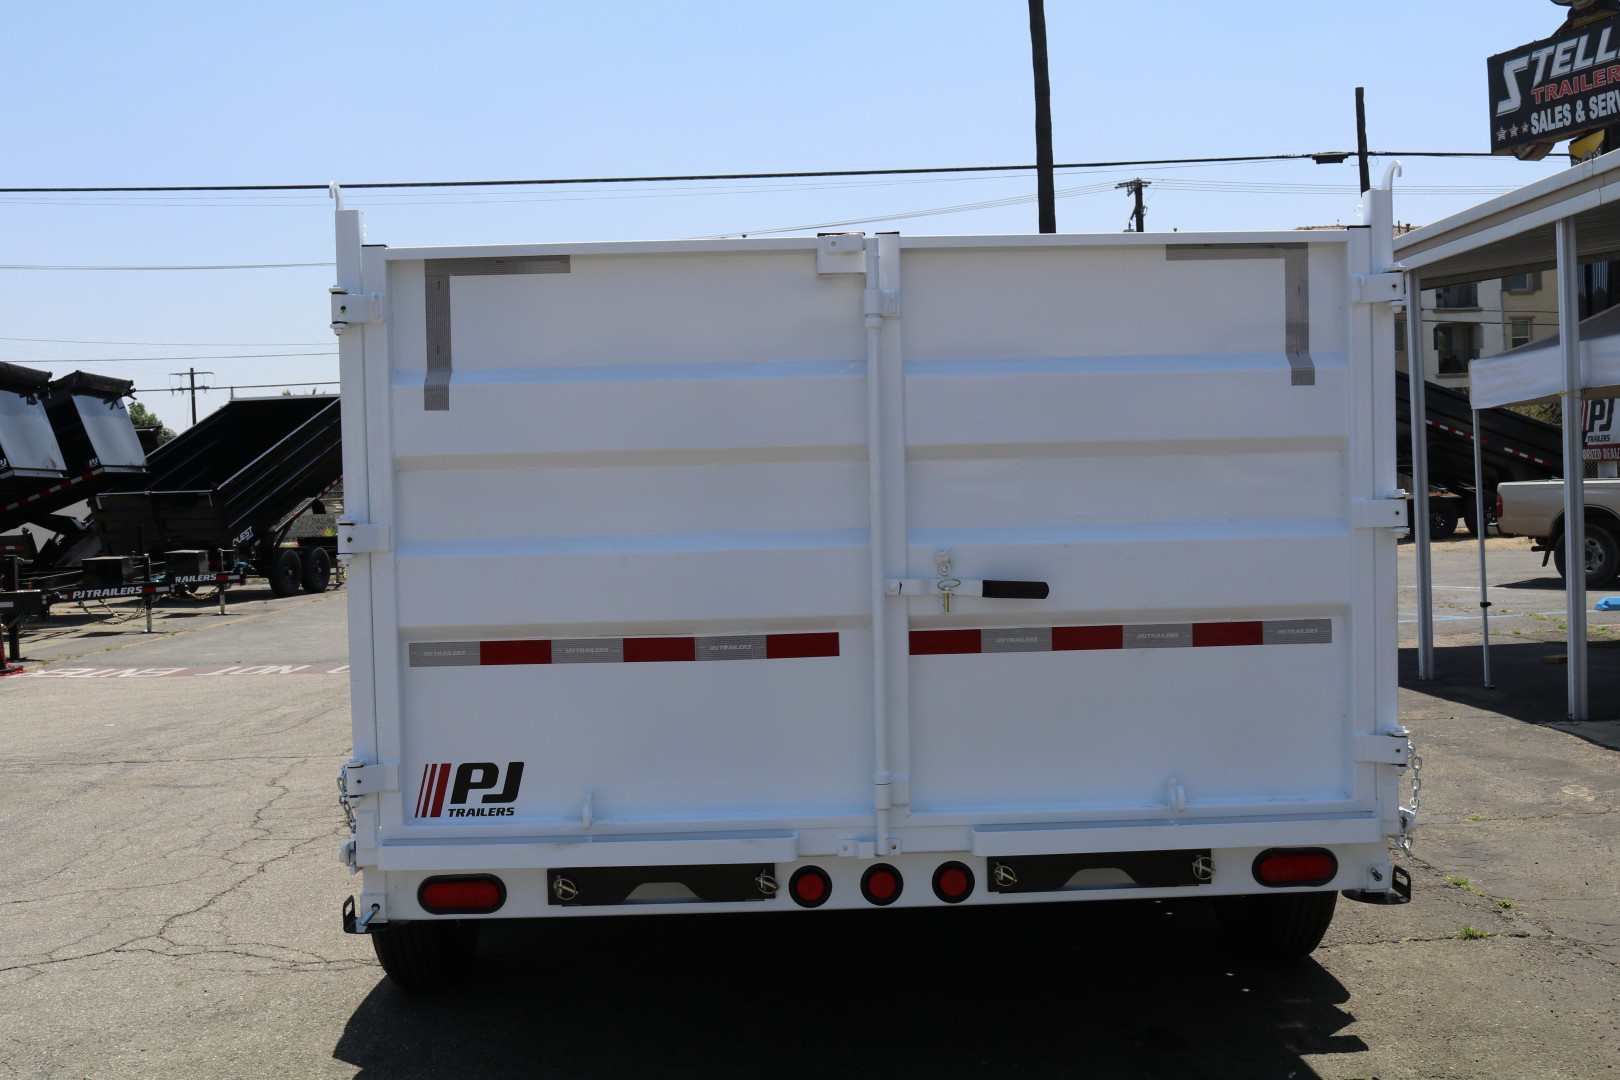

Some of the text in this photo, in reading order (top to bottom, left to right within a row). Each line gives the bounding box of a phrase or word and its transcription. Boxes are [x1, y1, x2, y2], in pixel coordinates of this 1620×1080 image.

[1496, 25, 1620, 117] STELL
[1530, 103, 1572, 135] SALES
[1575, 99, 1586, 123] &
[1588, 398, 1615, 432] PJ
[1587, 434, 1611, 443] TRAILERS
[174, 573, 217, 584] RAILERS
[86, 586, 143, 598] TRAILERS
[449, 761, 525, 805] PJ
[448, 807, 515, 817] TRAILERS
